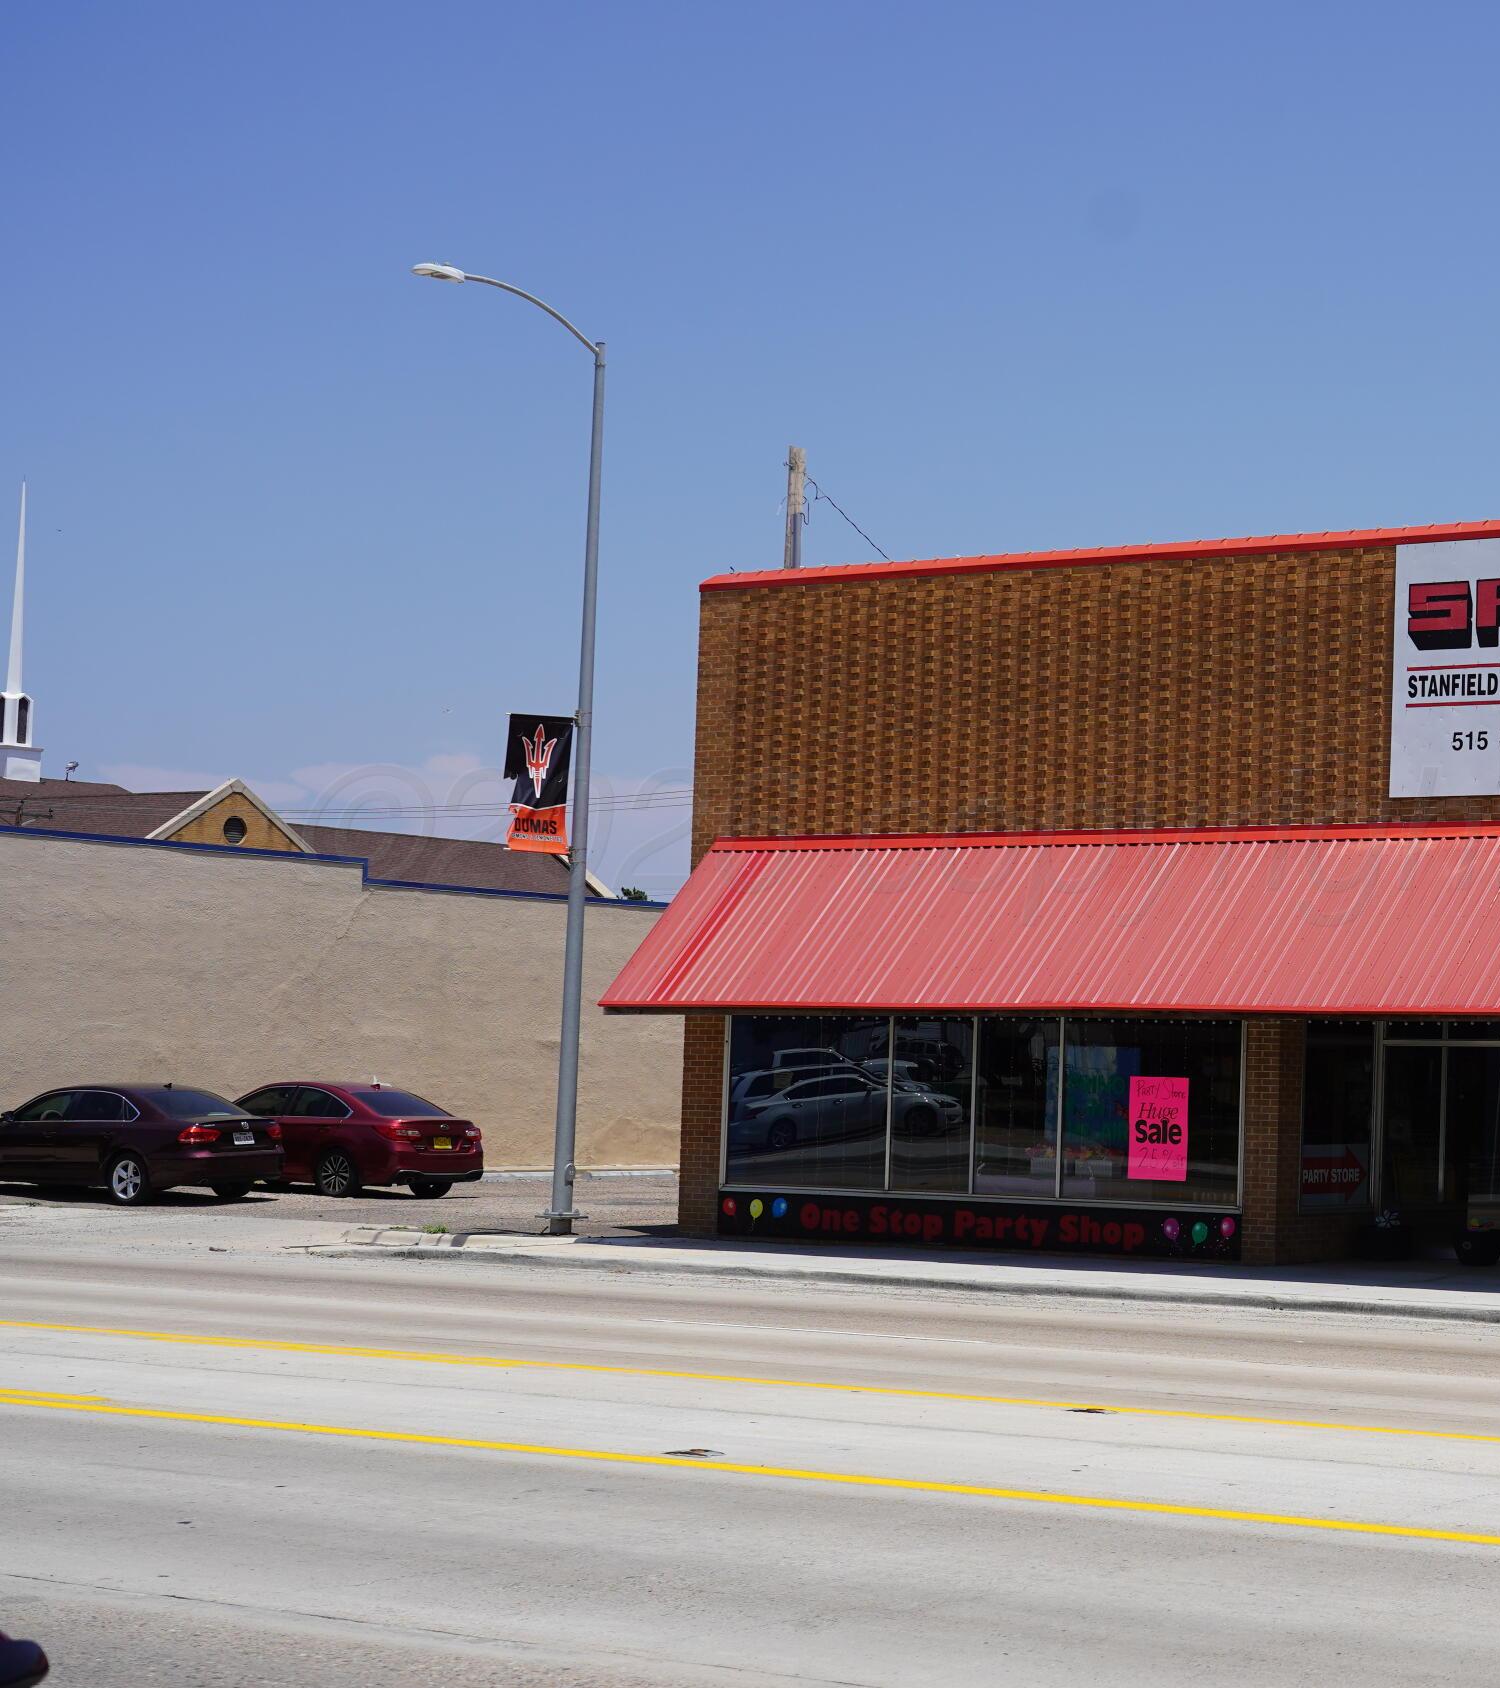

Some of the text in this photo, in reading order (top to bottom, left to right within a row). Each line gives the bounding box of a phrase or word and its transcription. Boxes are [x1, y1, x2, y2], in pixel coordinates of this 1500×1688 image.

[1407, 673, 1499, 698] STANFIELD
[1451, 731, 1489, 751] 515
[514, 817, 558, 834] DUMAS
[1137, 1102, 1179, 1123] Huge
[1135, 1119, 1182, 1144] Sale
[1302, 1167, 1360, 1184] PARTY STORE
[800, 1202, 1146, 1251] One Stop Party Shop
